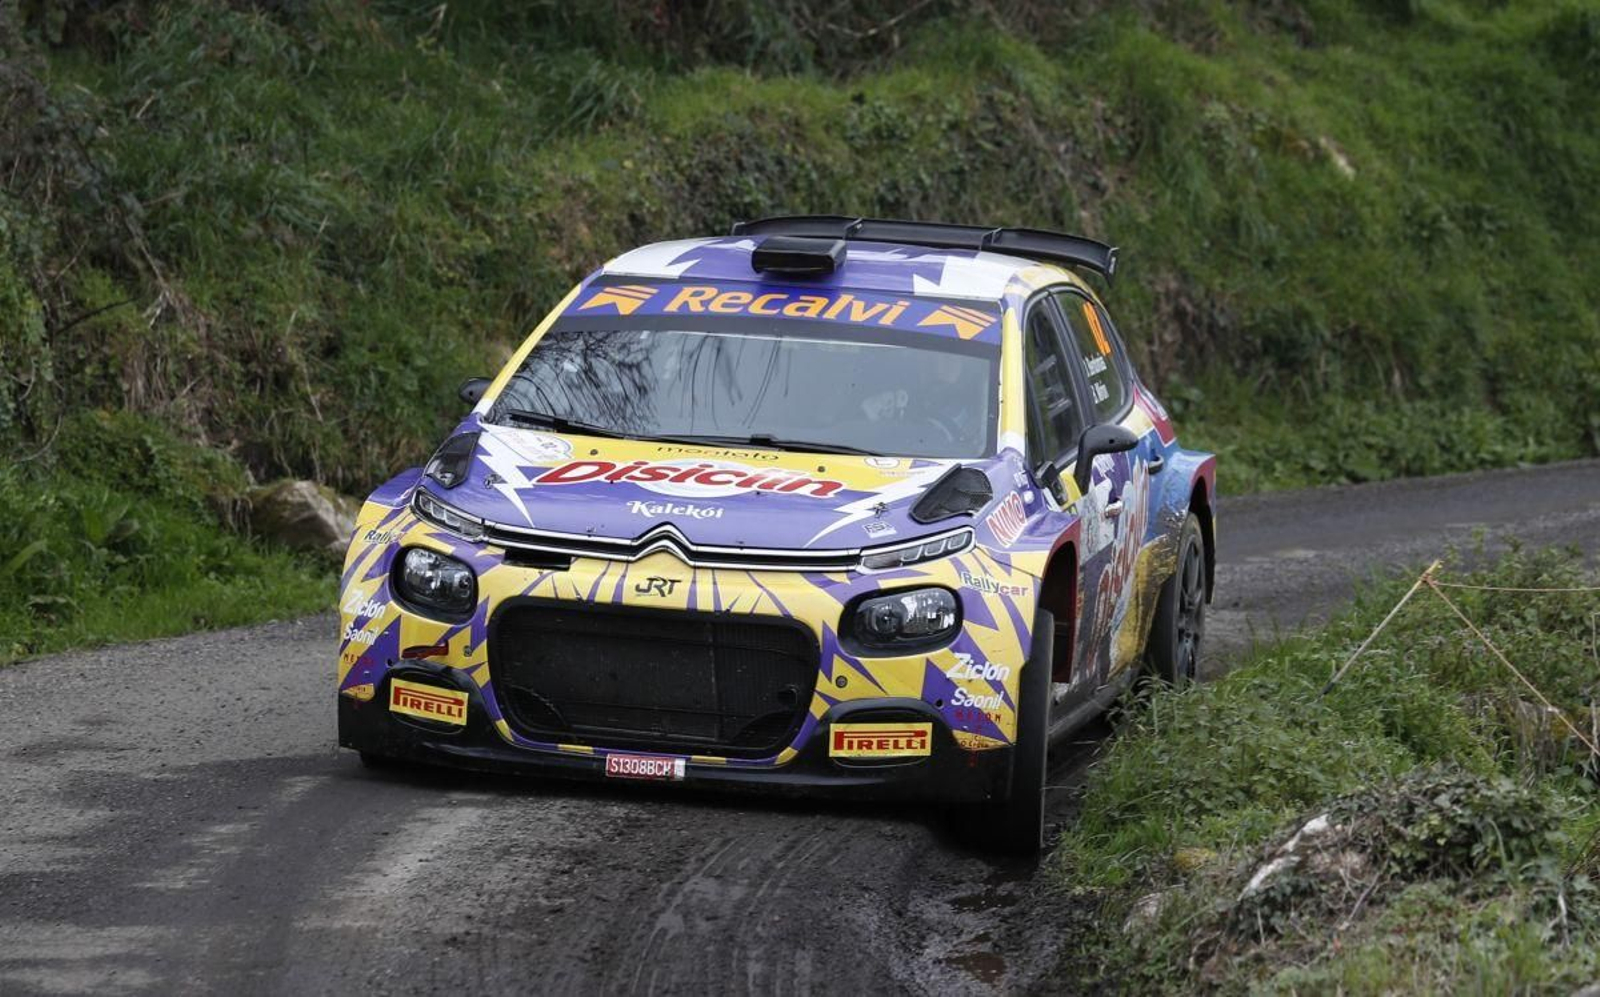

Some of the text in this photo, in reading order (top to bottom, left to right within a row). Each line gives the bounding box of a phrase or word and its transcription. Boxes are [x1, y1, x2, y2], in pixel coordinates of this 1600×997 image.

[664, 285, 911, 326] Recalvi
[535, 460, 843, 497] Disiclin
[635, 577, 682, 597] JRT
[960, 572, 1028, 597] Rallycar
[343, 622, 377, 646] Saonil
[393, 685, 465, 719] PIRELLI
[950, 686, 1004, 711] Saonil
[834, 730, 928, 751] PIRELLI
